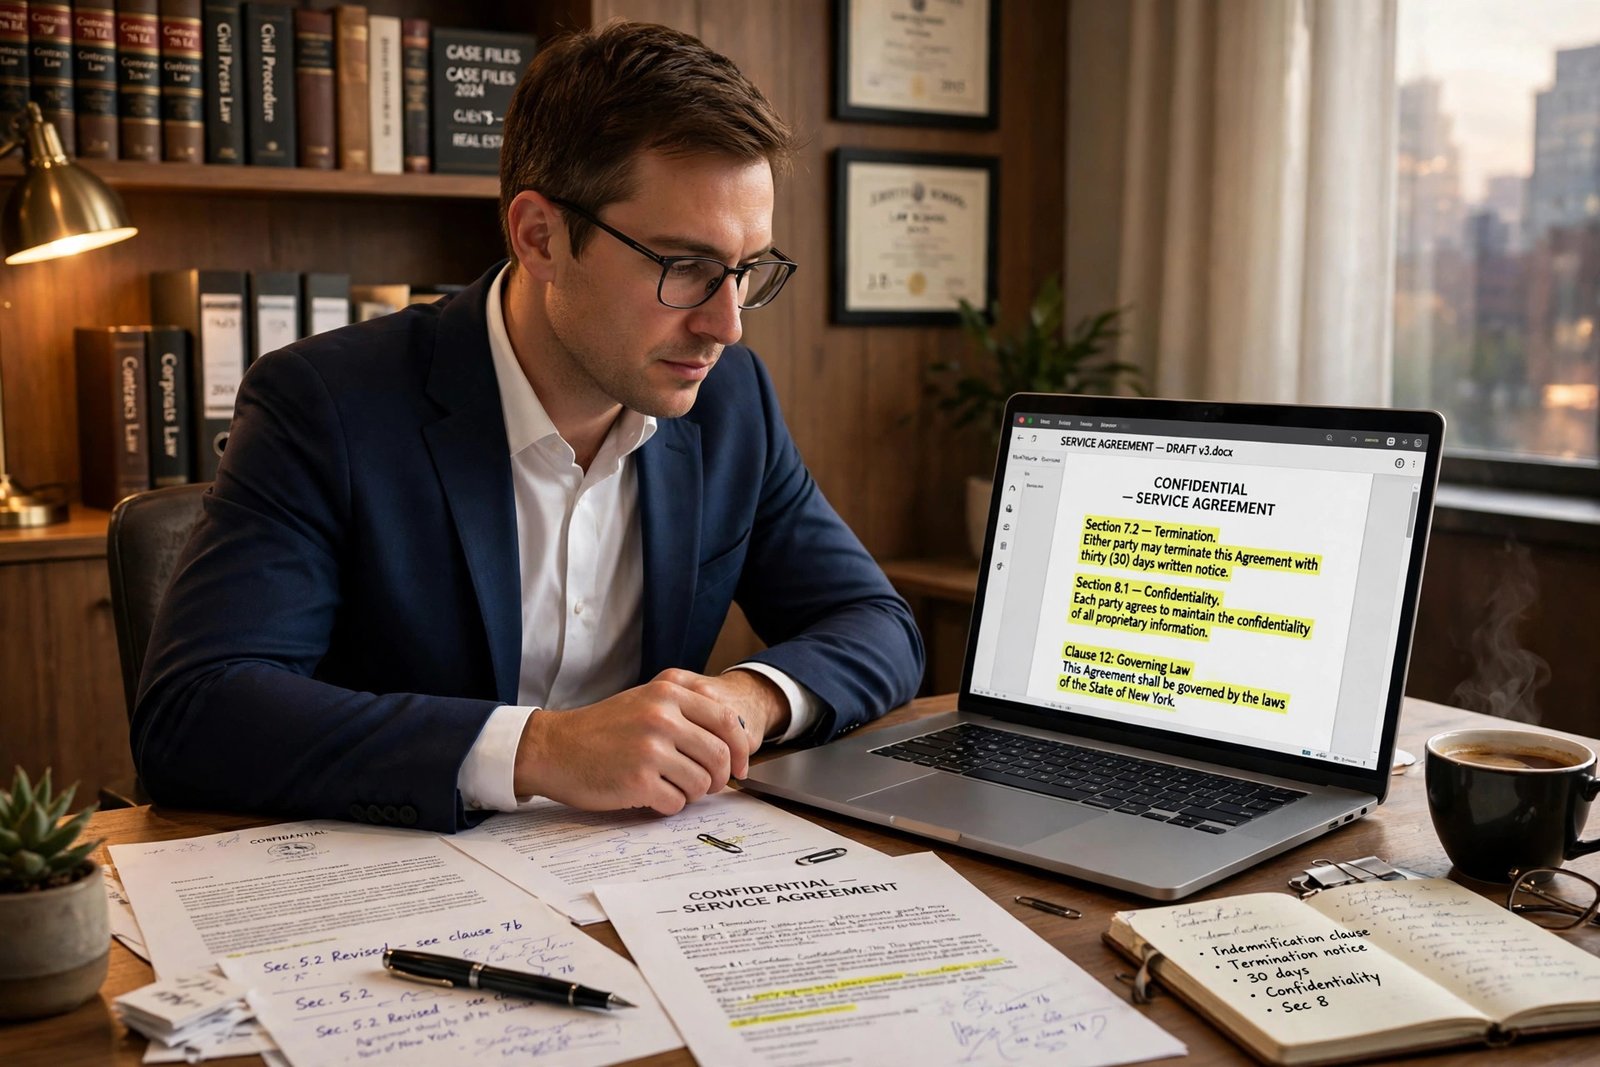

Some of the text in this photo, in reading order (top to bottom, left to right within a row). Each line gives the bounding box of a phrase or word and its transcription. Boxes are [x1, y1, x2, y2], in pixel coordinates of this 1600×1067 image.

[446, 45, 521, 65] CASE FILES
[217, 23, 233, 124] Civil Press Law
[261, 24, 278, 123] Civil Procedure
[446, 67, 516, 85] CASE FILES
[455, 84, 485, 98] 2024
[452, 133, 481, 148] REAL
[125, 424, 140, 453] Law
[164, 426, 180, 458] Law
[1061, 436, 1097, 449] SERVICE
[1098, 439, 1155, 452] AGREEMENT
[1166, 443, 1197, 455] DRAFT
[1199, 445, 1234, 458] v3.docx
[1154, 477, 1248, 496] CONFIDENTIAL
[1136, 491, 1190, 509] SERVICE
[1193, 496, 1276, 516] AGREEMENT
[1085, 518, 1121, 534] Section
[1124, 522, 1140, 535] 7.2
[1154, 525, 1216, 543] Termination.
[1081, 549, 1229, 578] thirty (30) days written notice.
[1083, 534, 1318, 571] Either party may terminate this Agreement with
[1076, 577, 1112, 593] Section
[1114, 582, 1130, 595] 8.1
[1144, 586, 1220, 607] Confidentiality.
[1071, 608, 1208, 638] of all proprietary information.
[1074, 592, 1311, 637] Each party agrees to maintain the confidentiality
[1065, 646, 1191, 676] Clause 12: Governing Law
[1059, 676, 1176, 708] of the State of New York.
[1063, 661, 1286, 710] This Agreement shall be governed by the laws
[683, 897, 770, 914] SERVICE
[776, 882, 899, 904] AGREEMENT
[689, 878, 835, 901] CONFIDENTIAL
[263, 962, 296, 974] Sec.
[300, 955, 324, 968] 5.2
[332, 943, 389, 962] Revised
[416, 937, 441, 948] see
[449, 927, 494, 943] clause
[501, 920, 523, 933] 7b
[1212, 928, 1371, 957] Indemnification clause
[1227, 943, 1368, 971] Termination notice
[1247, 965, 1310, 985] 30 days
[1266, 970, 1382, 1000] Confidentiality
[296, 988, 374, 1011] Sec. 5.2
[1282, 996, 1330, 1015] Sec 8
[316, 1025, 349, 1039] Sec.
[353, 1018, 381, 1031] 5.2
[388, 1003, 440, 1024] Revised
[465, 997, 487, 1008] see
